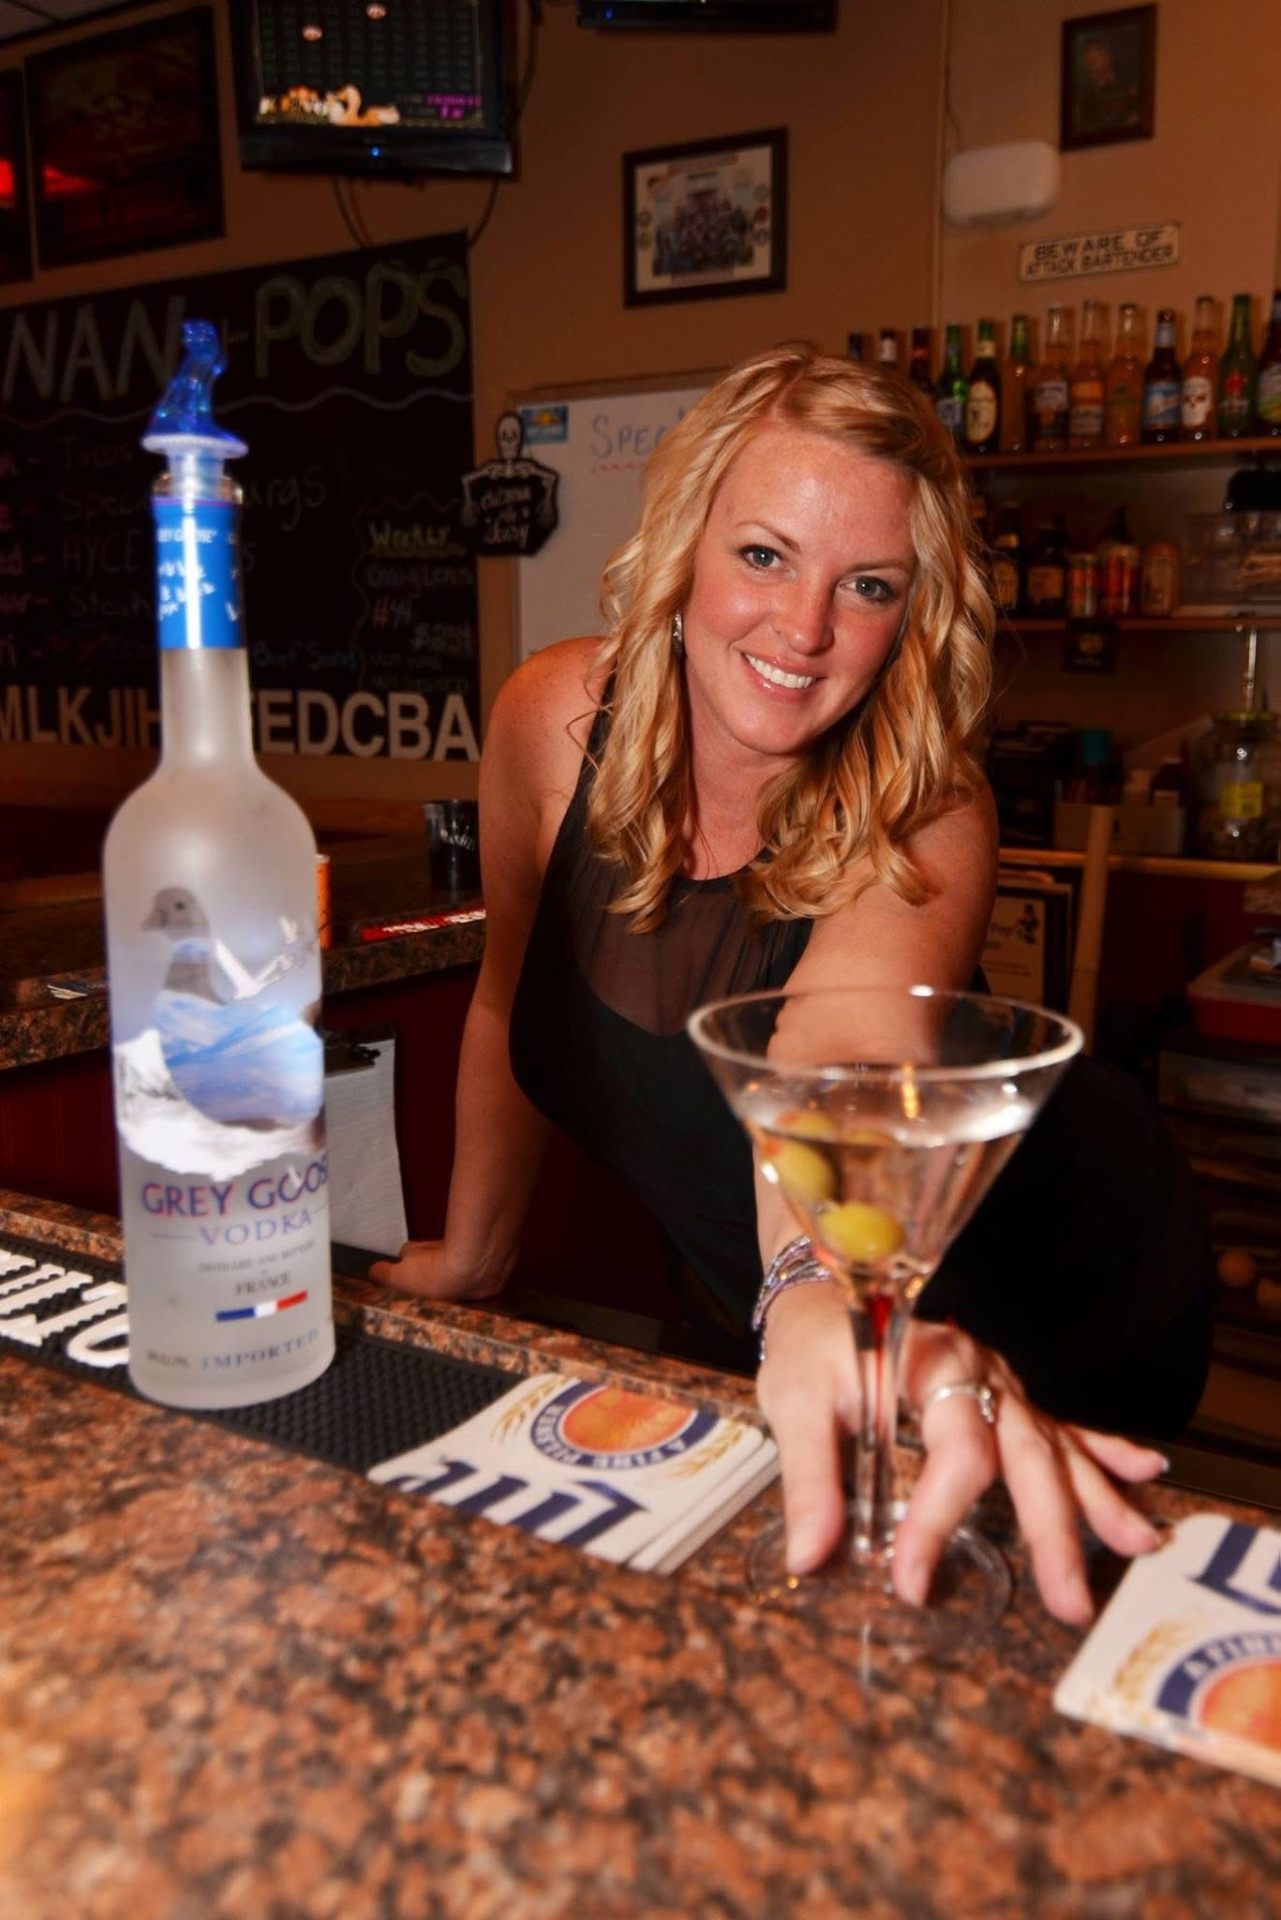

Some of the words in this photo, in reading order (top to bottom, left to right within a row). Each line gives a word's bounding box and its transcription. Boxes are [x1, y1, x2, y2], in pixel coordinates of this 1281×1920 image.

[1033, 234, 1124, 262] BEWARE
[1135, 230, 1164, 248] OF
[1081, 244, 1174, 271] BARTENDER
[141, 1180, 234, 1218] GREY
[200, 1206, 313, 1246] VODKA
[201, 1327, 319, 1369] IMPORTED
